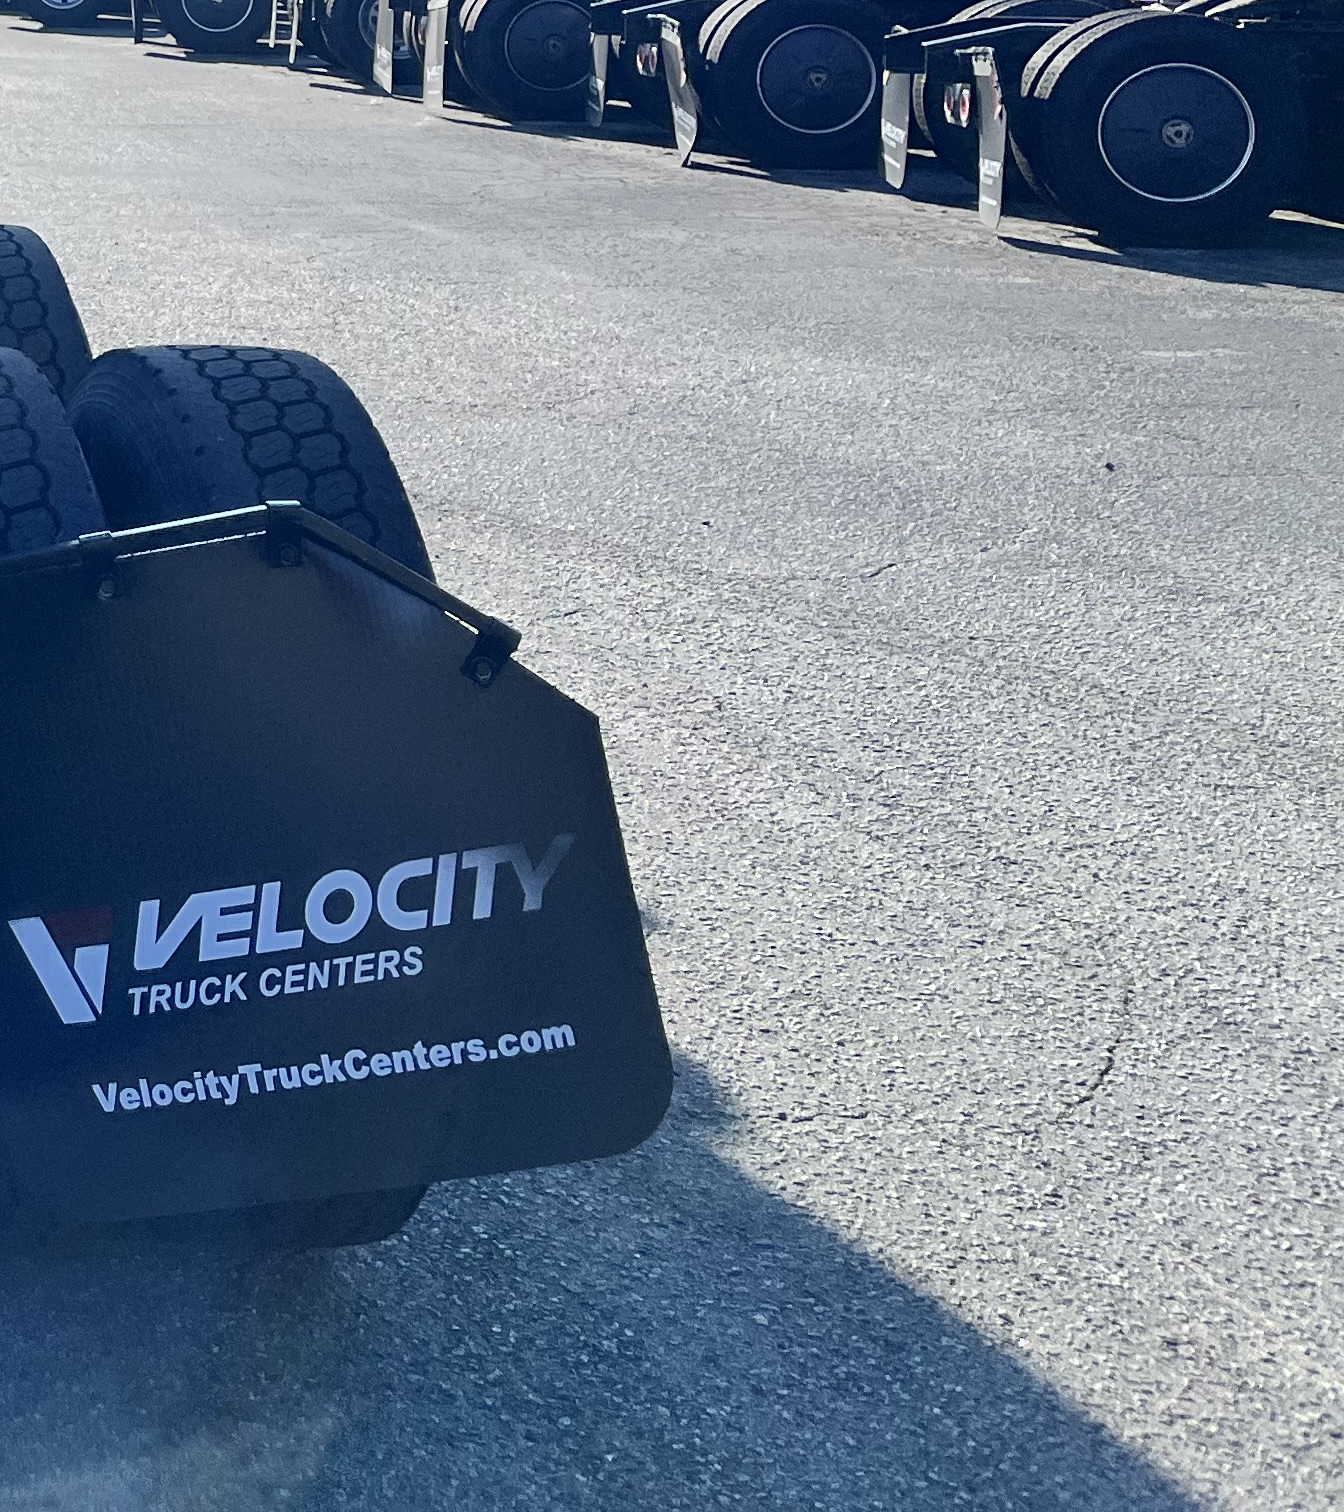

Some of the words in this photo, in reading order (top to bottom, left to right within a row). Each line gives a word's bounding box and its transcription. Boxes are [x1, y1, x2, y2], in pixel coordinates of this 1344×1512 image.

[133, 833, 576, 971] VELOCITY
[127, 971, 249, 1016] TRUCK
[259, 946, 424, 997] CENTERS
[91, 1024, 576, 1113] VelocityTruckCenters.com
